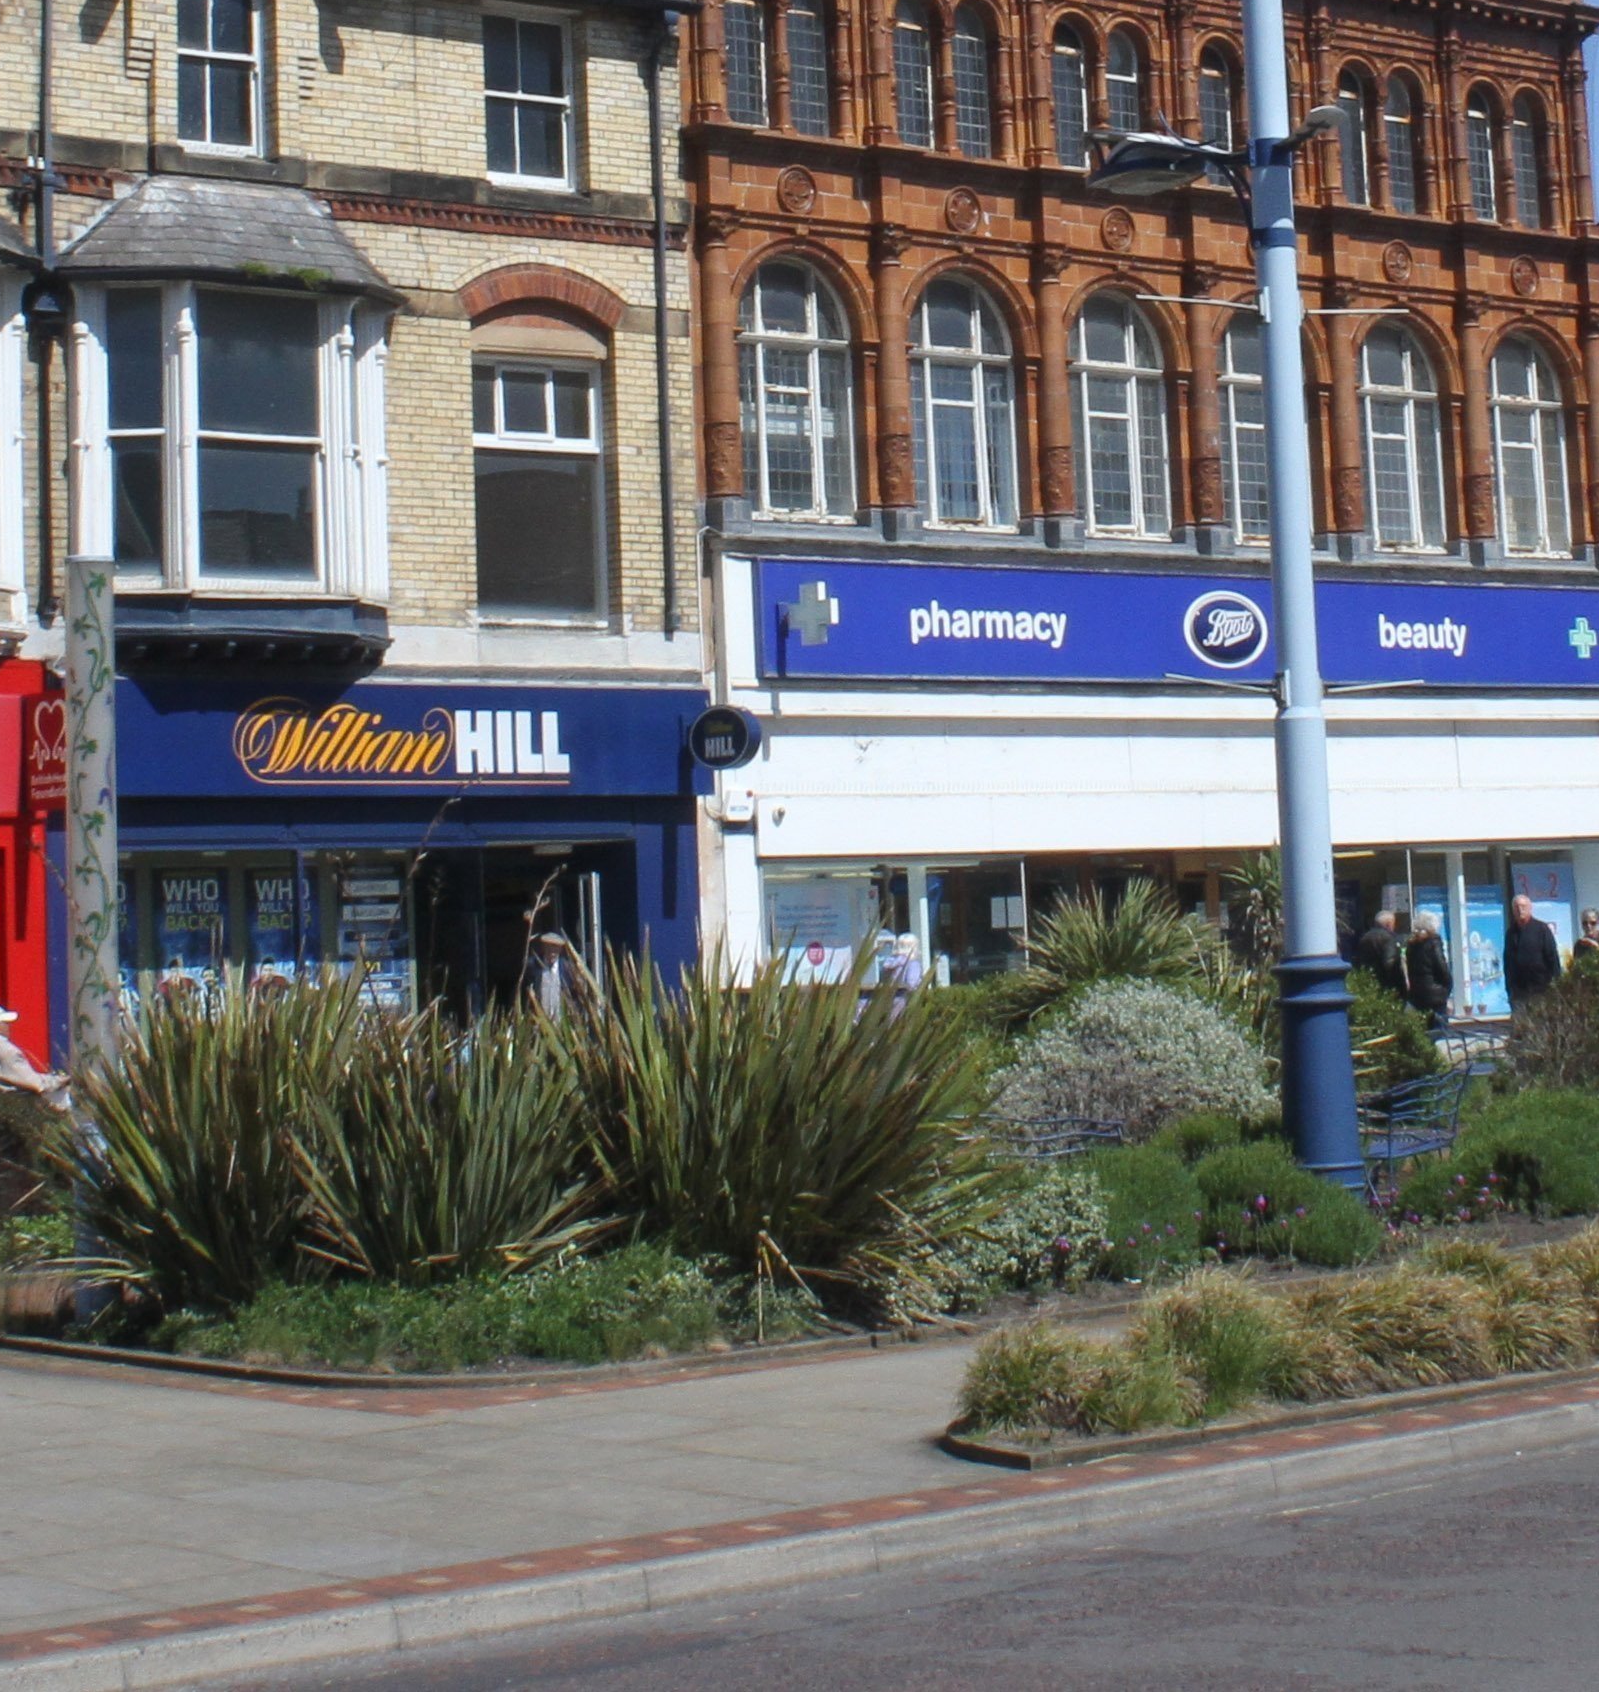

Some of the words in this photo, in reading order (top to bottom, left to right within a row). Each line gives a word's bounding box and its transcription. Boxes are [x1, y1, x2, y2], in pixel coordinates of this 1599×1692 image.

[909, 599, 1068, 649] pharmacy
[1202, 608, 1255, 647] Boots
[1378, 613, 1467, 657] beauty
[232, 696, 453, 784] William
[455, 710, 570, 774] HILL
[704, 735, 736, 758] HILL
[161, 879, 219, 901] WHO
